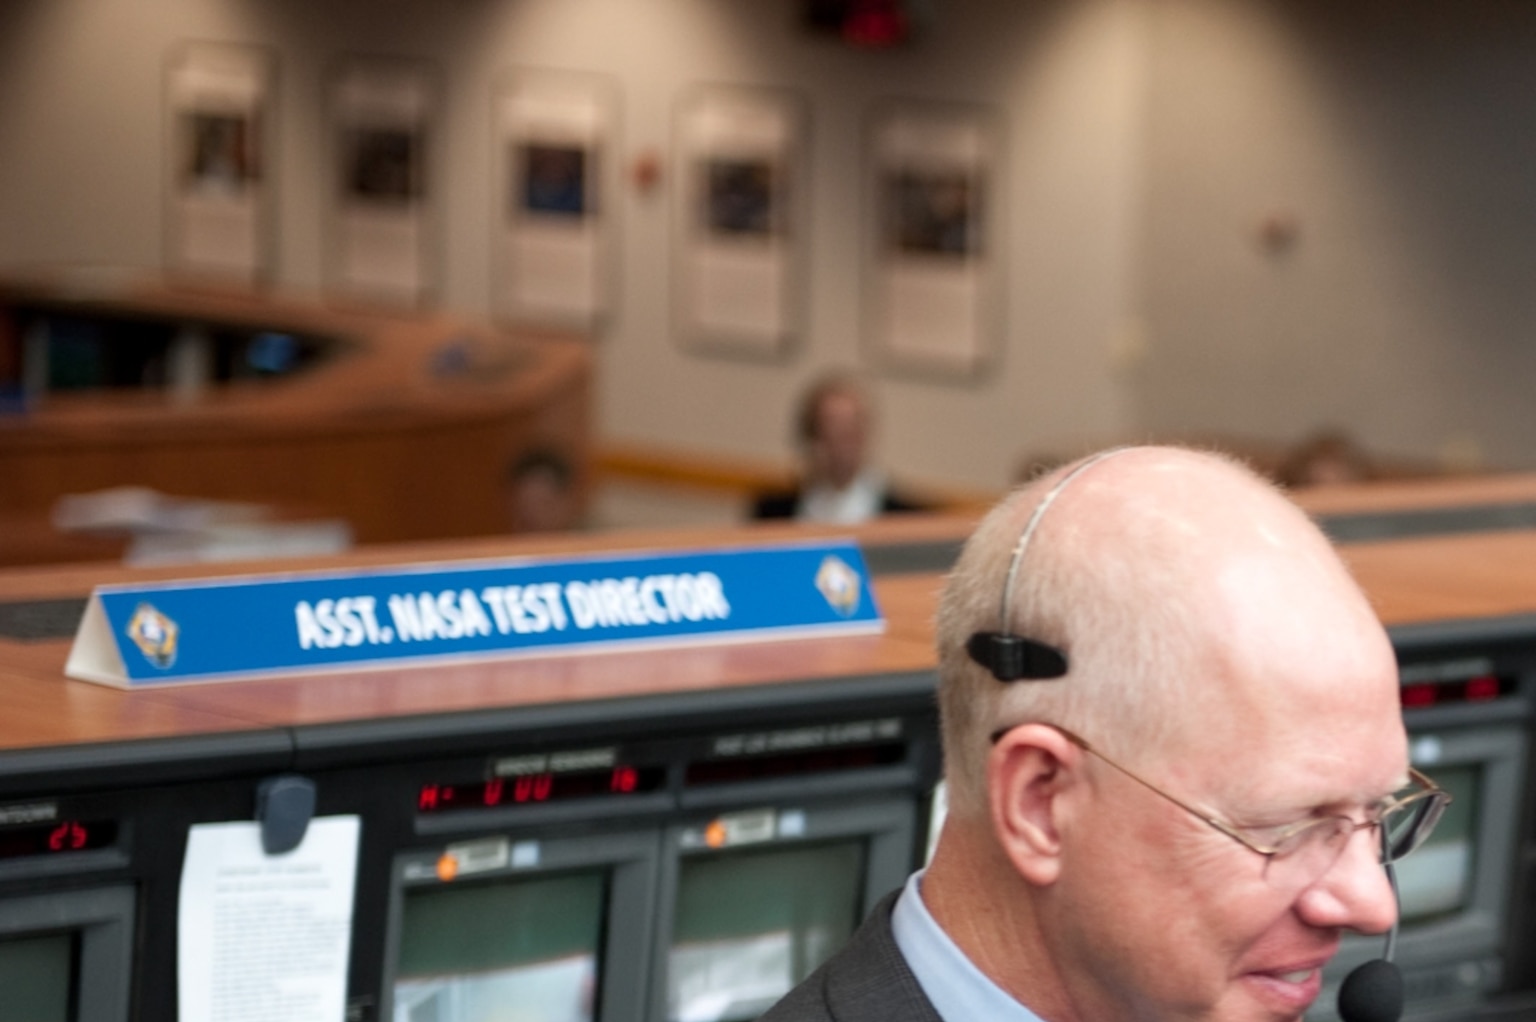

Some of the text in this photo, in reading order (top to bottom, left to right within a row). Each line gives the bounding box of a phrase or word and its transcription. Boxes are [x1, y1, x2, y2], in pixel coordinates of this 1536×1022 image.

[295, 571, 731, 650] ASST. NASA TEST DIRECTOR
